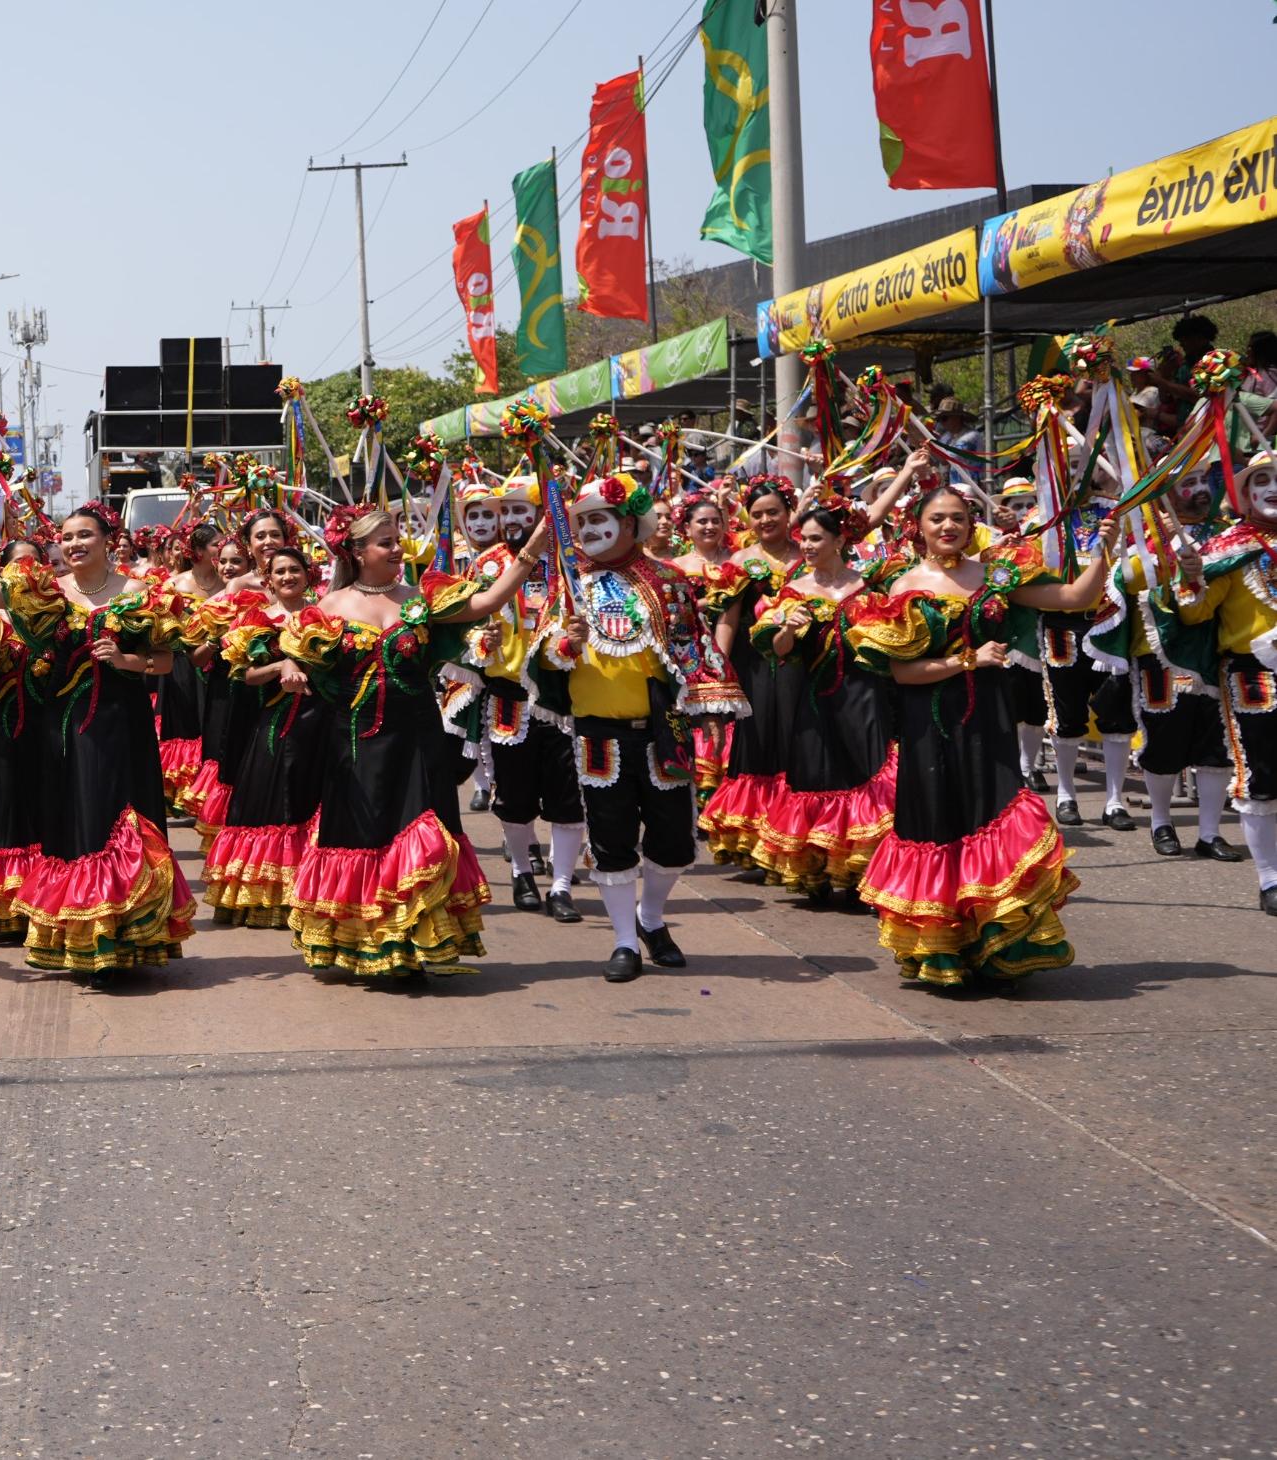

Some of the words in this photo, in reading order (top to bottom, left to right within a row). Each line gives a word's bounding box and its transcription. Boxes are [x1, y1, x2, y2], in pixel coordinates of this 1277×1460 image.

[1136, 164, 1215, 227] éxito
[836, 277, 869, 320] éxito
[875, 262, 916, 308] éxito
[921, 246, 967, 294] éxito
[559, 520, 571, 546] Cipote
